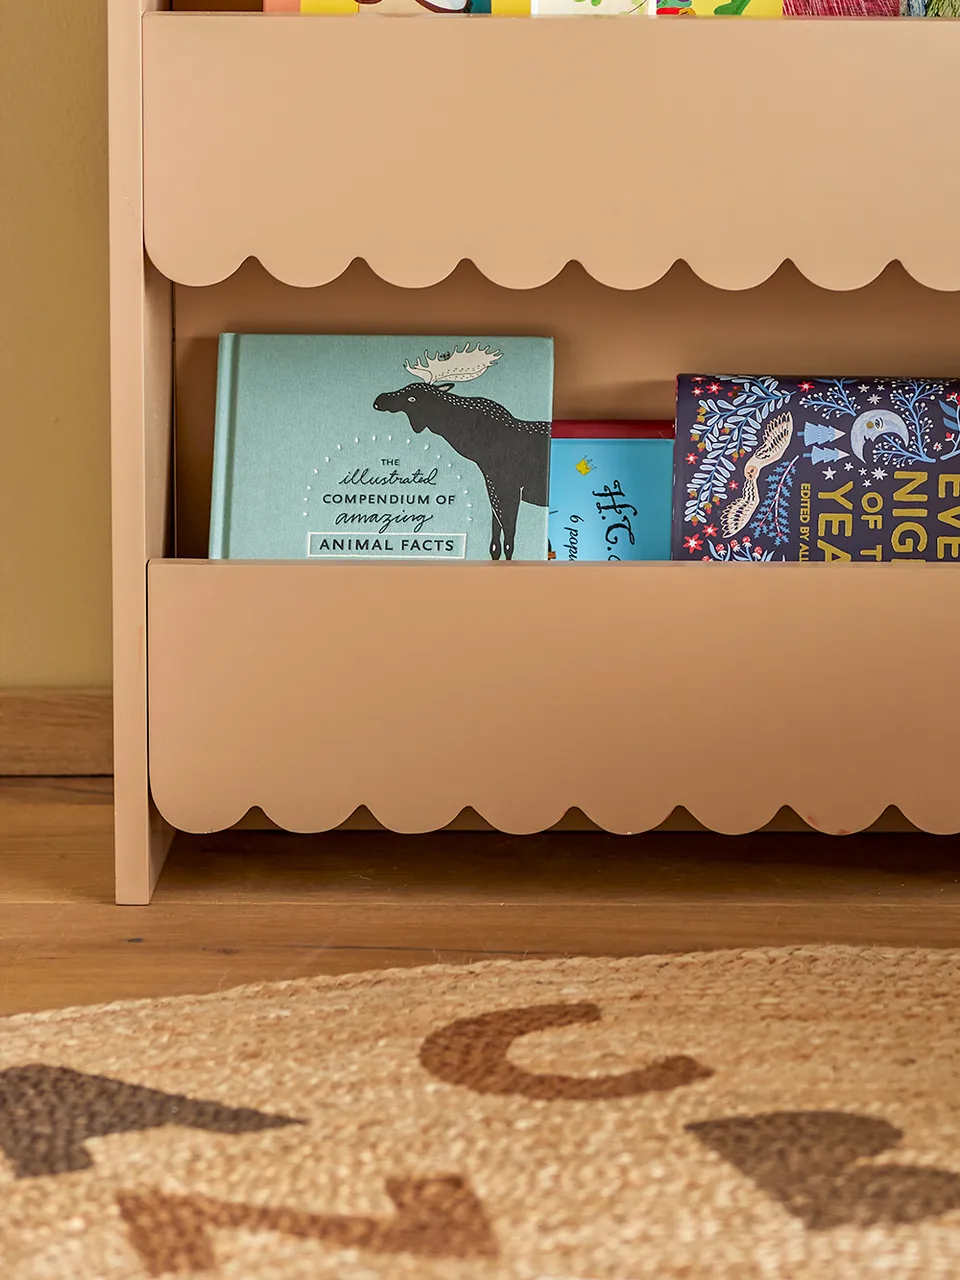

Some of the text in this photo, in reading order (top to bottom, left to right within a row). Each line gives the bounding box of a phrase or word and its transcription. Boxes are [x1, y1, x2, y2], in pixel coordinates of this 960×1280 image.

[381, 458, 400, 466] THE
[338, 468, 438, 486] illustrated
[322, 493, 456, 505] COMPENDIUM OF
[799, 483, 811, 523] EDITED
[861, 492, 884, 529] OF
[891, 471, 928, 562] NIG
[335, 509, 434, 534] amazing
[817, 481, 853, 562] YEA
[800, 526, 810, 541] BY
[319, 538, 455, 551] ANIMAL FACTS
